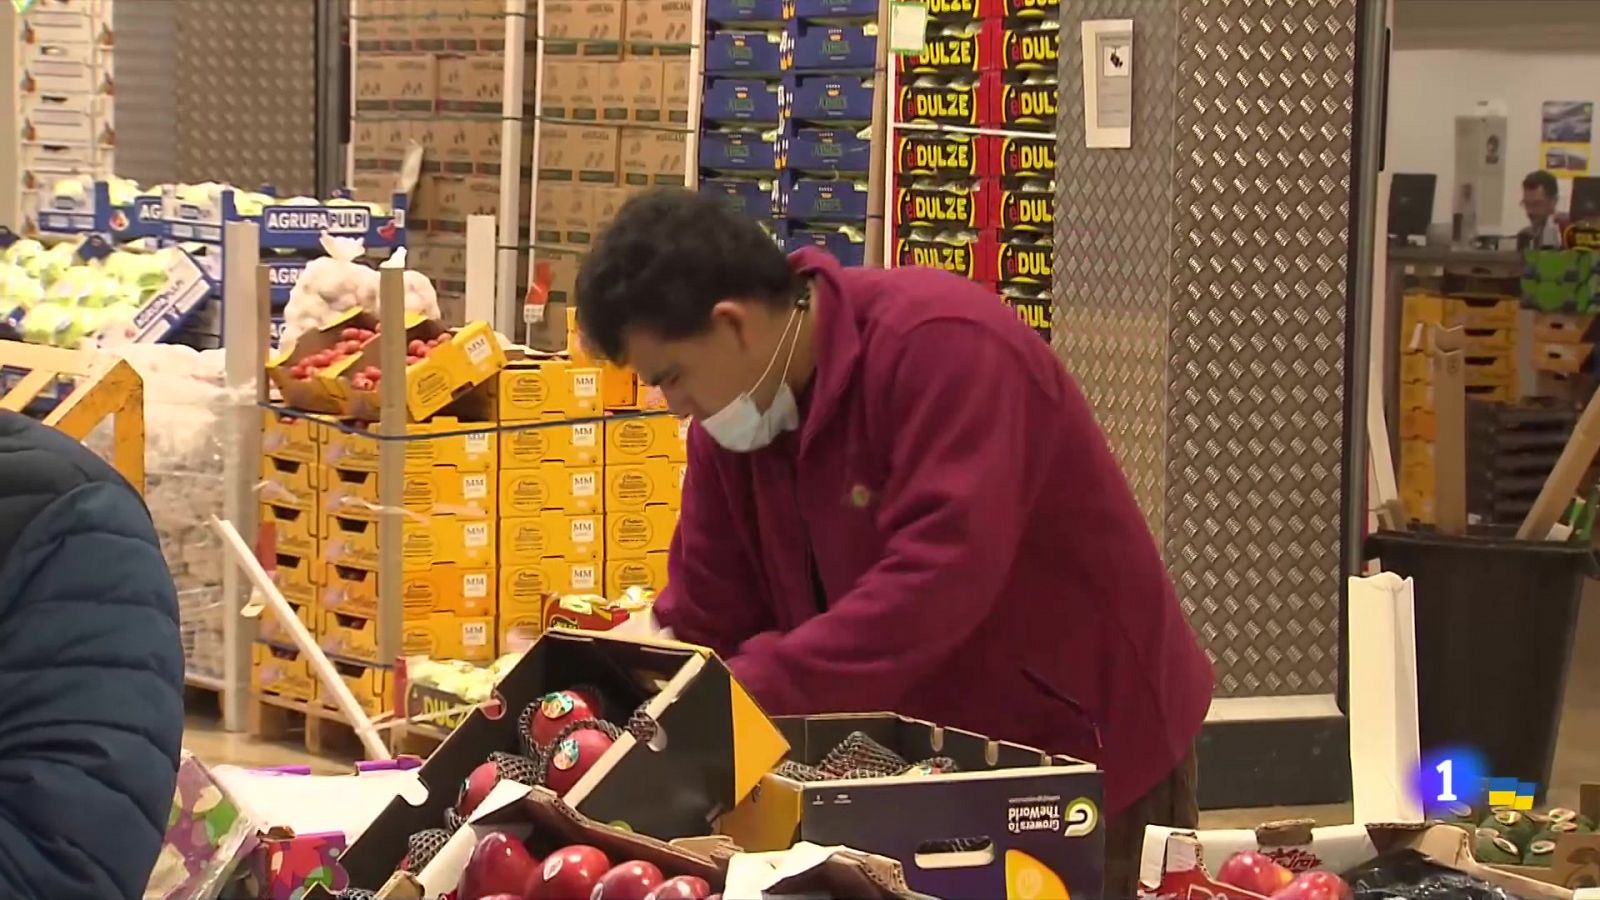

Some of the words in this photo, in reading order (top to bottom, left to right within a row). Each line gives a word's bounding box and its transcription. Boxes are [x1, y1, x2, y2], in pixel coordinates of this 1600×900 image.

[1022, 35, 1059, 60] DUL
[917, 94, 969, 117] DULZE
[1021, 91, 1058, 115] DUL
[916, 144, 969, 168] DULZE
[1021, 145, 1057, 169] DUL
[915, 197, 968, 220] DULZE
[1020, 199, 1055, 222] DUL
[268, 212, 368, 230] AGRUPAPULPI
[914, 247, 967, 271] DULZE
[1017, 251, 1054, 276] DUL
[1016, 304, 1053, 329] DUL
[575, 376, 595, 386] MM
[574, 427, 594, 436] MM
[574, 476, 594, 486] MM
[573, 523, 593, 533] MM
[573, 569, 593, 579] MM
